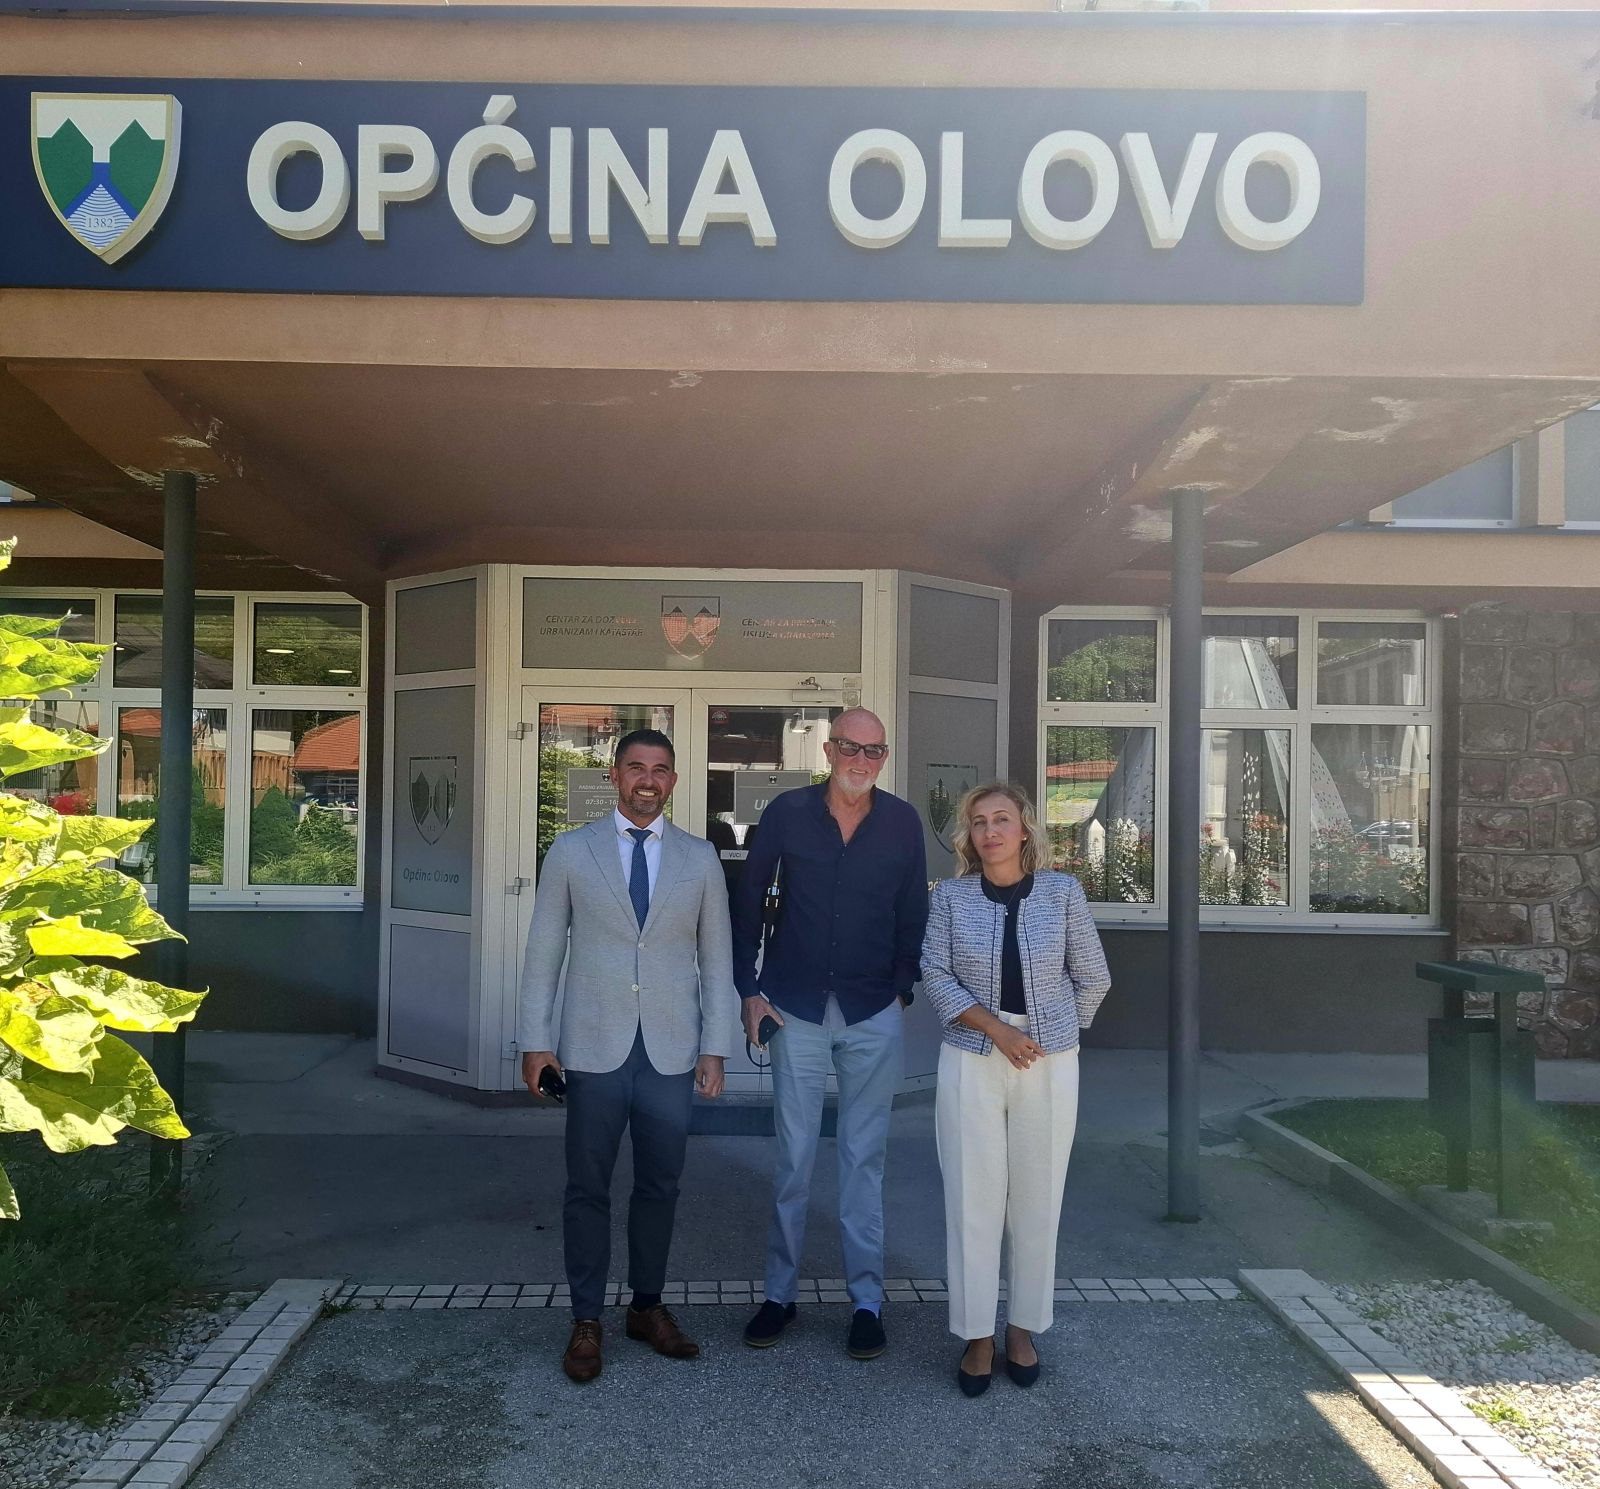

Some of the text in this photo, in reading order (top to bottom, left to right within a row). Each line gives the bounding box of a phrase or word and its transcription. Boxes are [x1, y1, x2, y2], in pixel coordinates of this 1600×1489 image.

[247, 95, 1321, 250] OPĆINA OLOVO
[88, 217, 113, 228] 1382
[545, 615, 580, 624] CENTAR
[581, 615, 593, 624] ZA
[539, 627, 593, 636] URBANIZAM
[599, 627, 644, 637] KATASTAR
